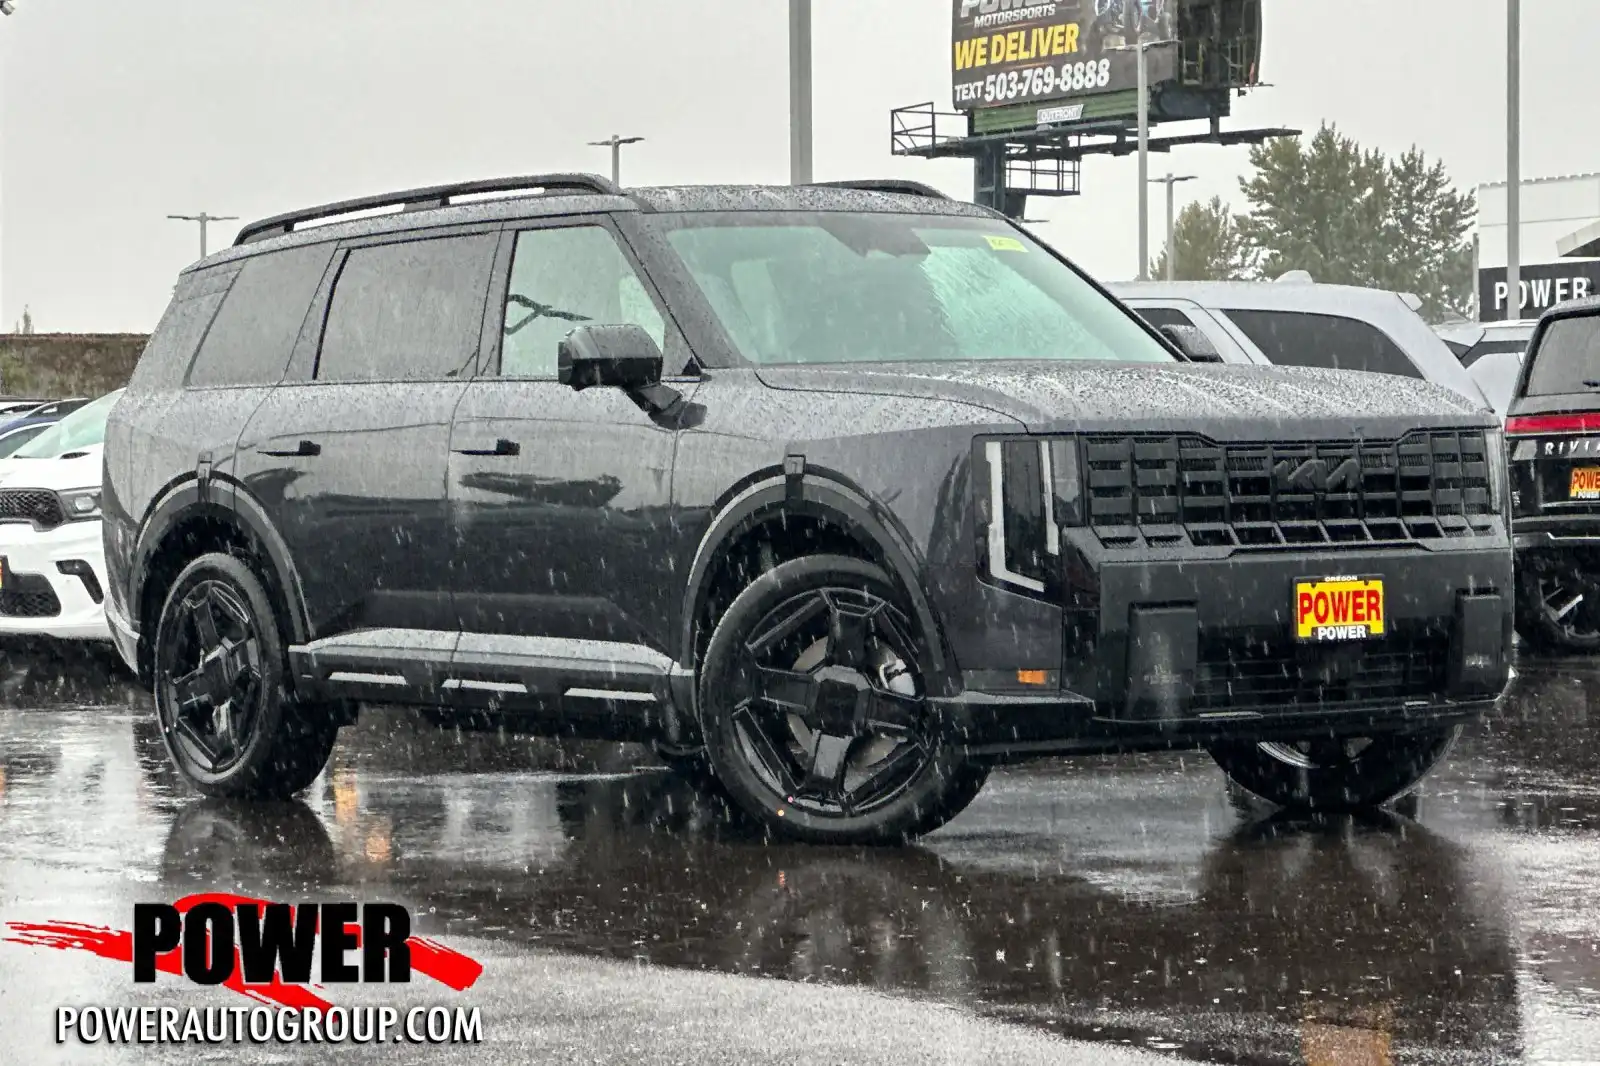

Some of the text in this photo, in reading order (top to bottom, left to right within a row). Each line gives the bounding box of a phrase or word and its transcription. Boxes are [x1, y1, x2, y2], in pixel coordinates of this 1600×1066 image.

[974, 4, 1056, 28] MOTORSPORTS
[954, 23, 1079, 71] WE DELIVER
[954, 58, 1110, 102] TEXT 503-769-8888
[1041, 107, 1079, 121] OUTFRONT
[1299, 589, 1381, 624] POWER
[1317, 625, 1367, 640] POWER
